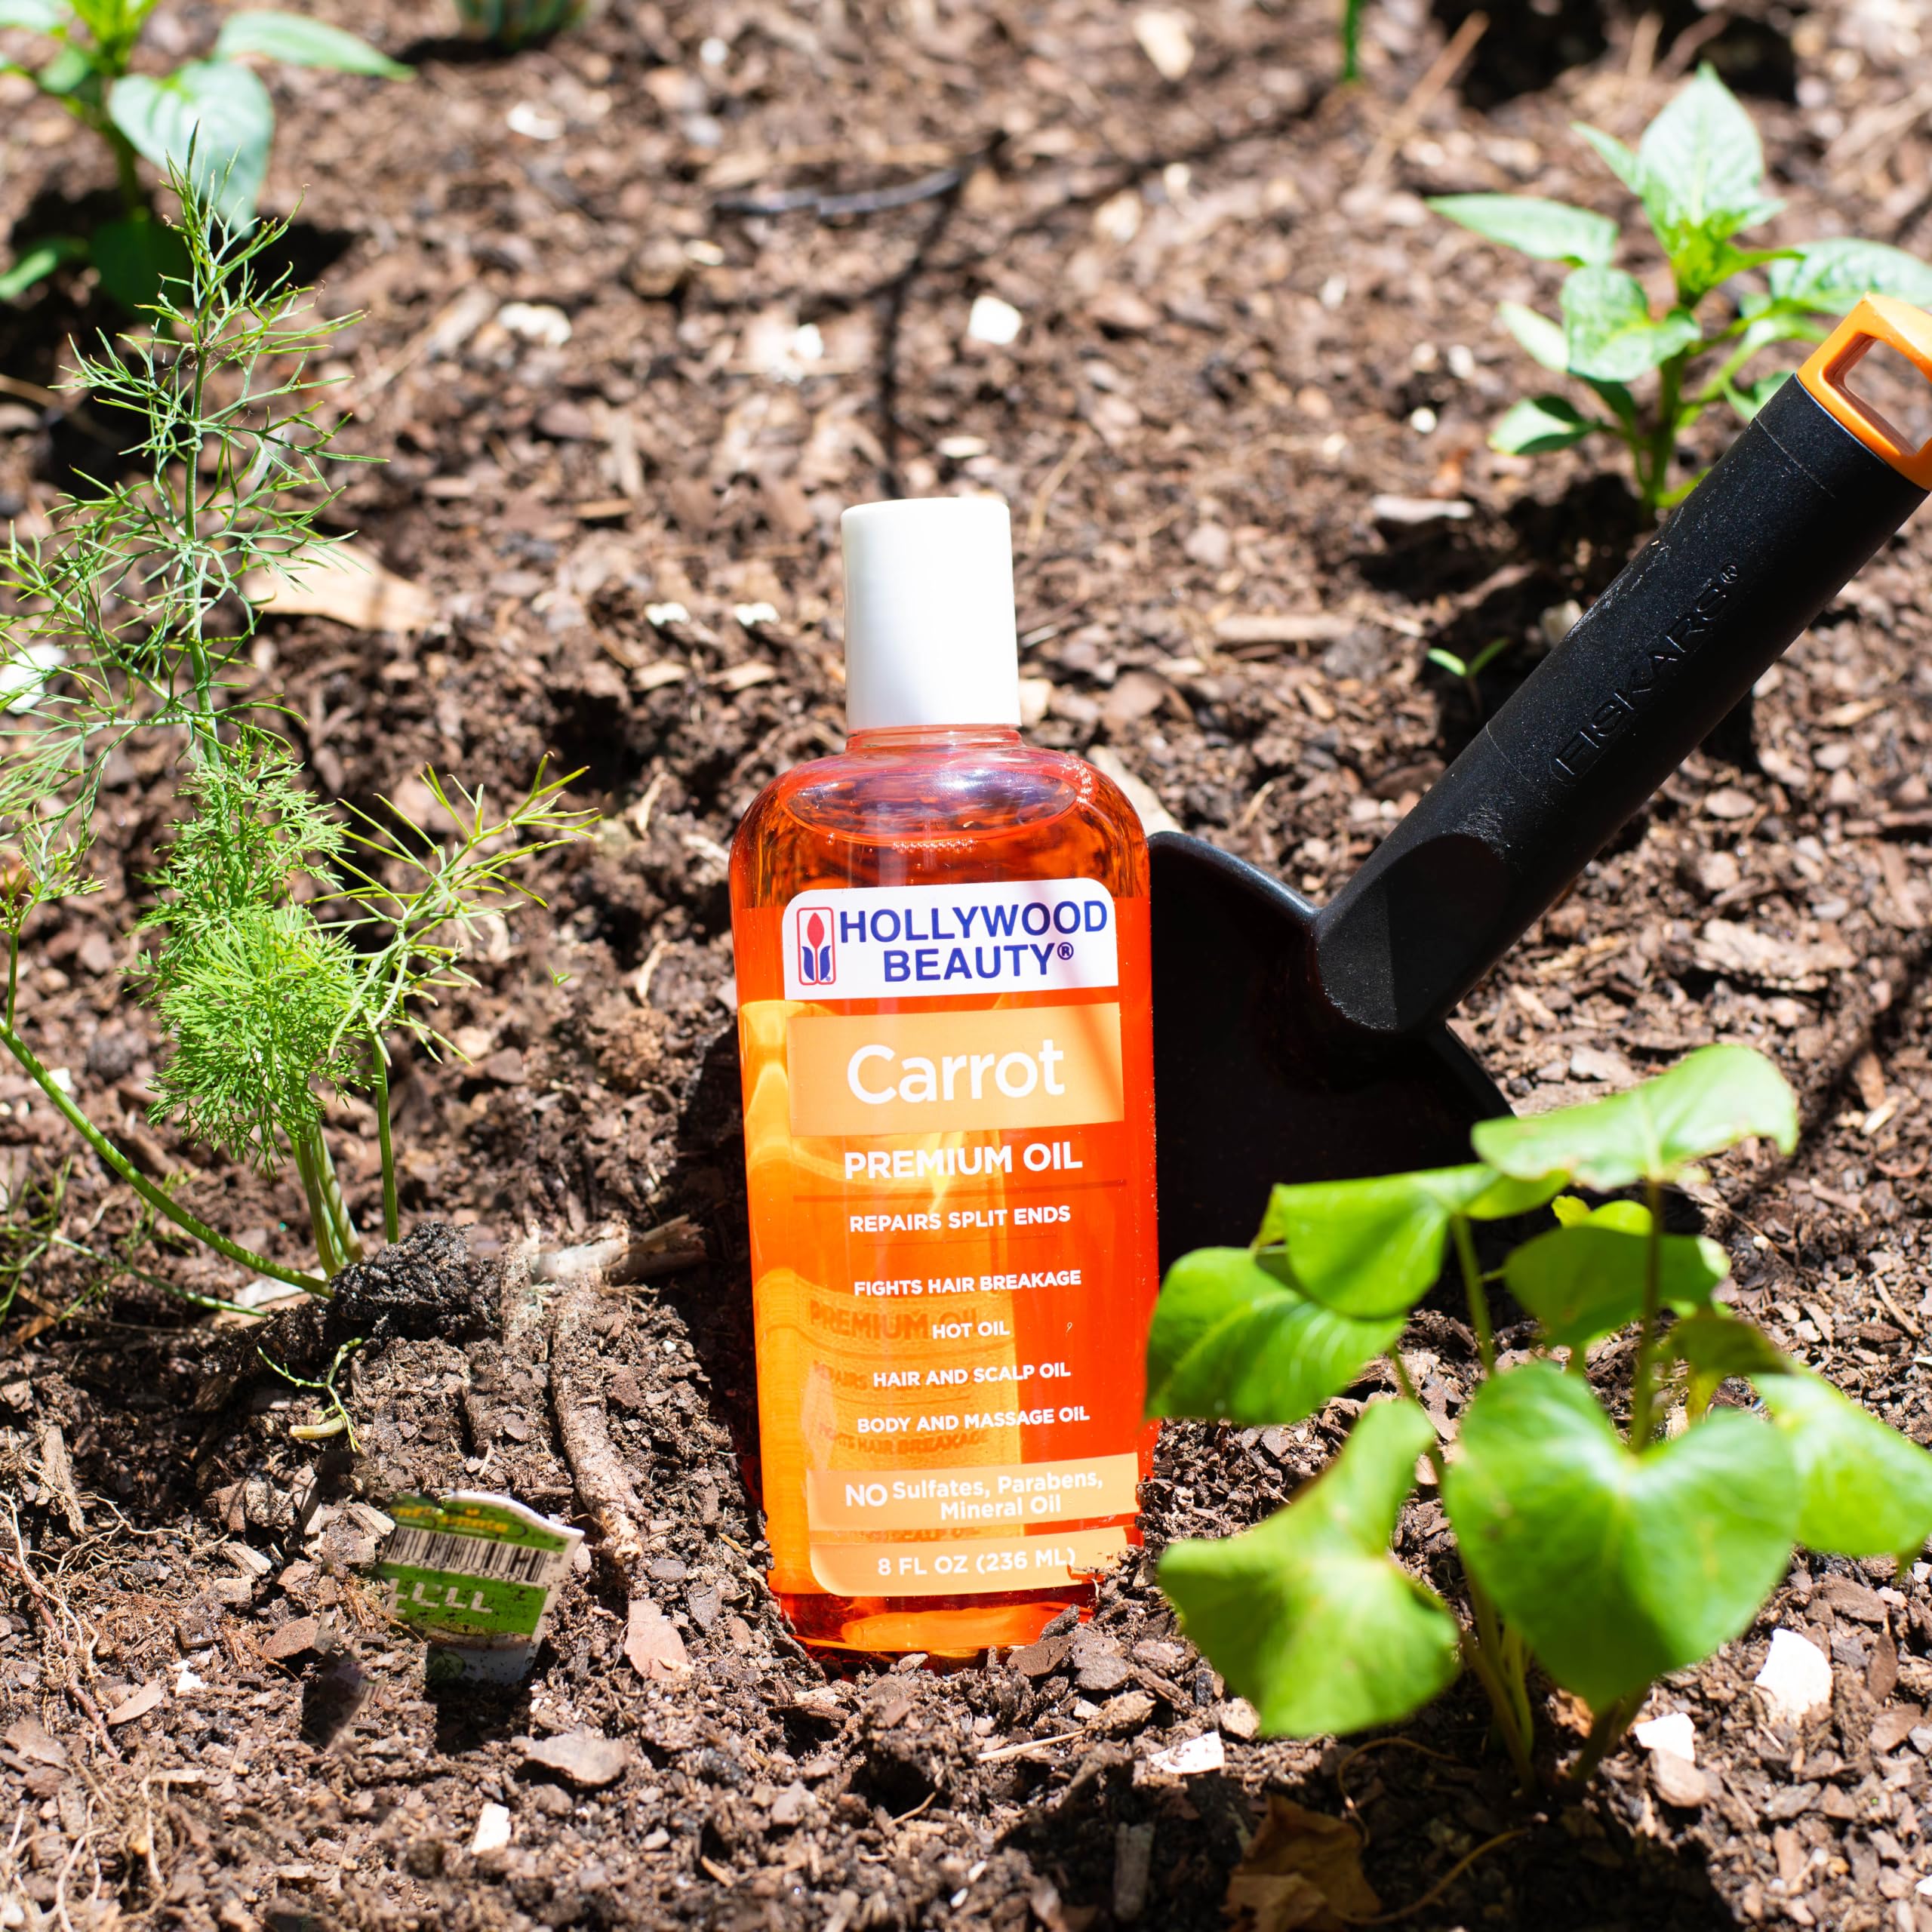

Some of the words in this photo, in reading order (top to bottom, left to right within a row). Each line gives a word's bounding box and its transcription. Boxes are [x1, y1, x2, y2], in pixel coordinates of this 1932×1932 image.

[840, 900, 1107, 943] HOLLYWOOD
[847, 1038, 1066, 1105] Carrot
[844, 1145, 1013, 1180] PREMIUM
[1023, 1141, 1083, 1172] OIL
[849, 1214, 942, 1232] REPAIRS
[948, 1208, 1008, 1229] SPLIT
[1014, 1204, 1071, 1226] ENDS
[854, 1279, 923, 1297] FIGHTS
[928, 1276, 976, 1294] HAIR
[979, 1269, 1081, 1291] BREAKAGE
[932, 1322, 973, 1340] HOT
[977, 1320, 1011, 1337] OIL
[872, 1371, 921, 1387] HAIR
[925, 1368, 969, 1386] AND
[973, 1364, 1035, 1383] SCALP
[1041, 1361, 1072, 1379] OIL
[857, 1417, 912, 1434] BODY
[915, 1414, 960, 1432] AND
[964, 1407, 1055, 1429] MASSAGE
[1058, 1405, 1091, 1423] OIL
[845, 1483, 888, 1506] NO
[892, 1479, 990, 1499] Sulfates,
[997, 1471, 1103, 1495] Parabens,
[940, 1497, 1023, 1520] Mineral
[1032, 1494, 1061, 1515] Oil
[878, 1558, 891, 1576] 8
[899, 1557, 928, 1575] FL
[934, 1555, 968, 1574] OZ
[975, 1549, 1028, 1574] (236
[1035, 1546, 1076, 1568] ML)
